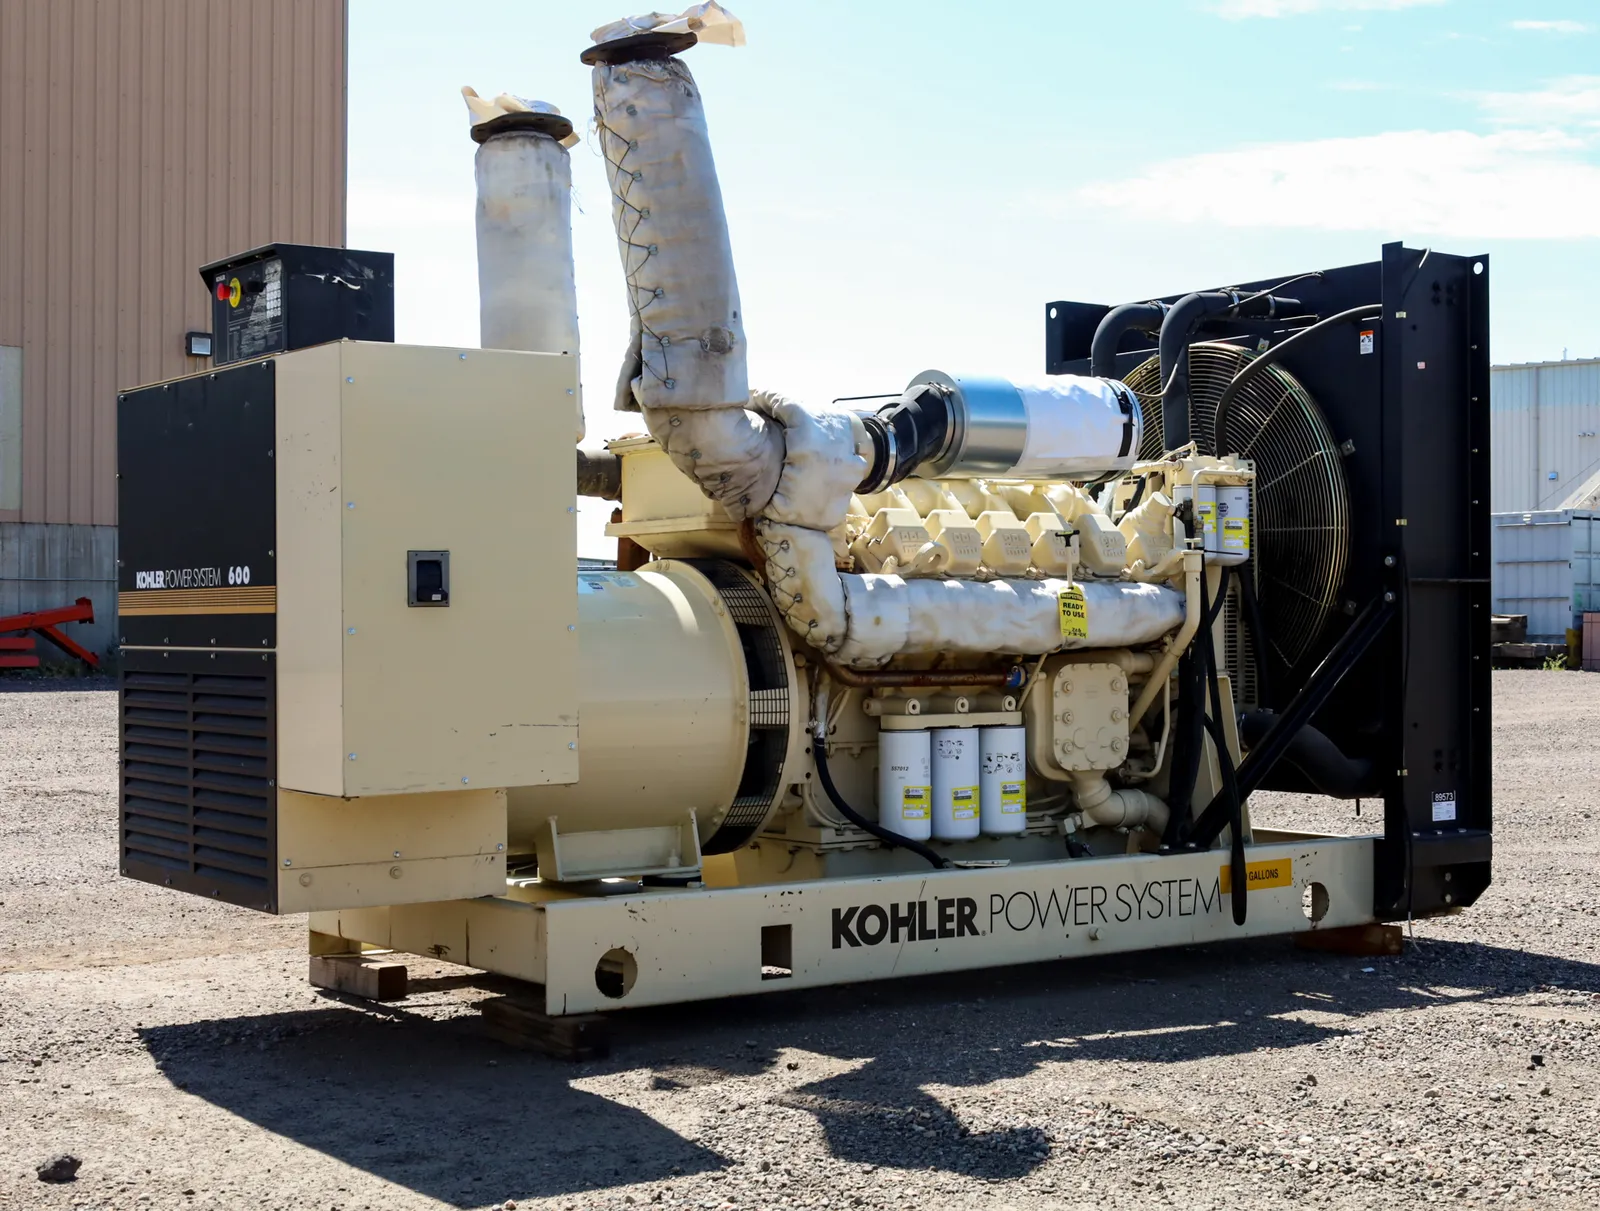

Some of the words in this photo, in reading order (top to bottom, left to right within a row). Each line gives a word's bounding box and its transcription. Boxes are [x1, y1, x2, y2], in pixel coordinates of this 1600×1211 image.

[136, 570, 165, 589] KOHLER
[166, 568, 193, 588] POWER
[193, 567, 221, 587] SYSTEM
[228, 565, 250, 585] 600
[1063, 602, 1083, 610] READY
[1435, 792, 1453, 801] 89573
[1249, 869, 1279, 881] GALLONS
[832, 897, 981, 949] KOHLER
[990, 884, 1108, 933] POWER
[1114, 876, 1222, 922] SYSTEM
